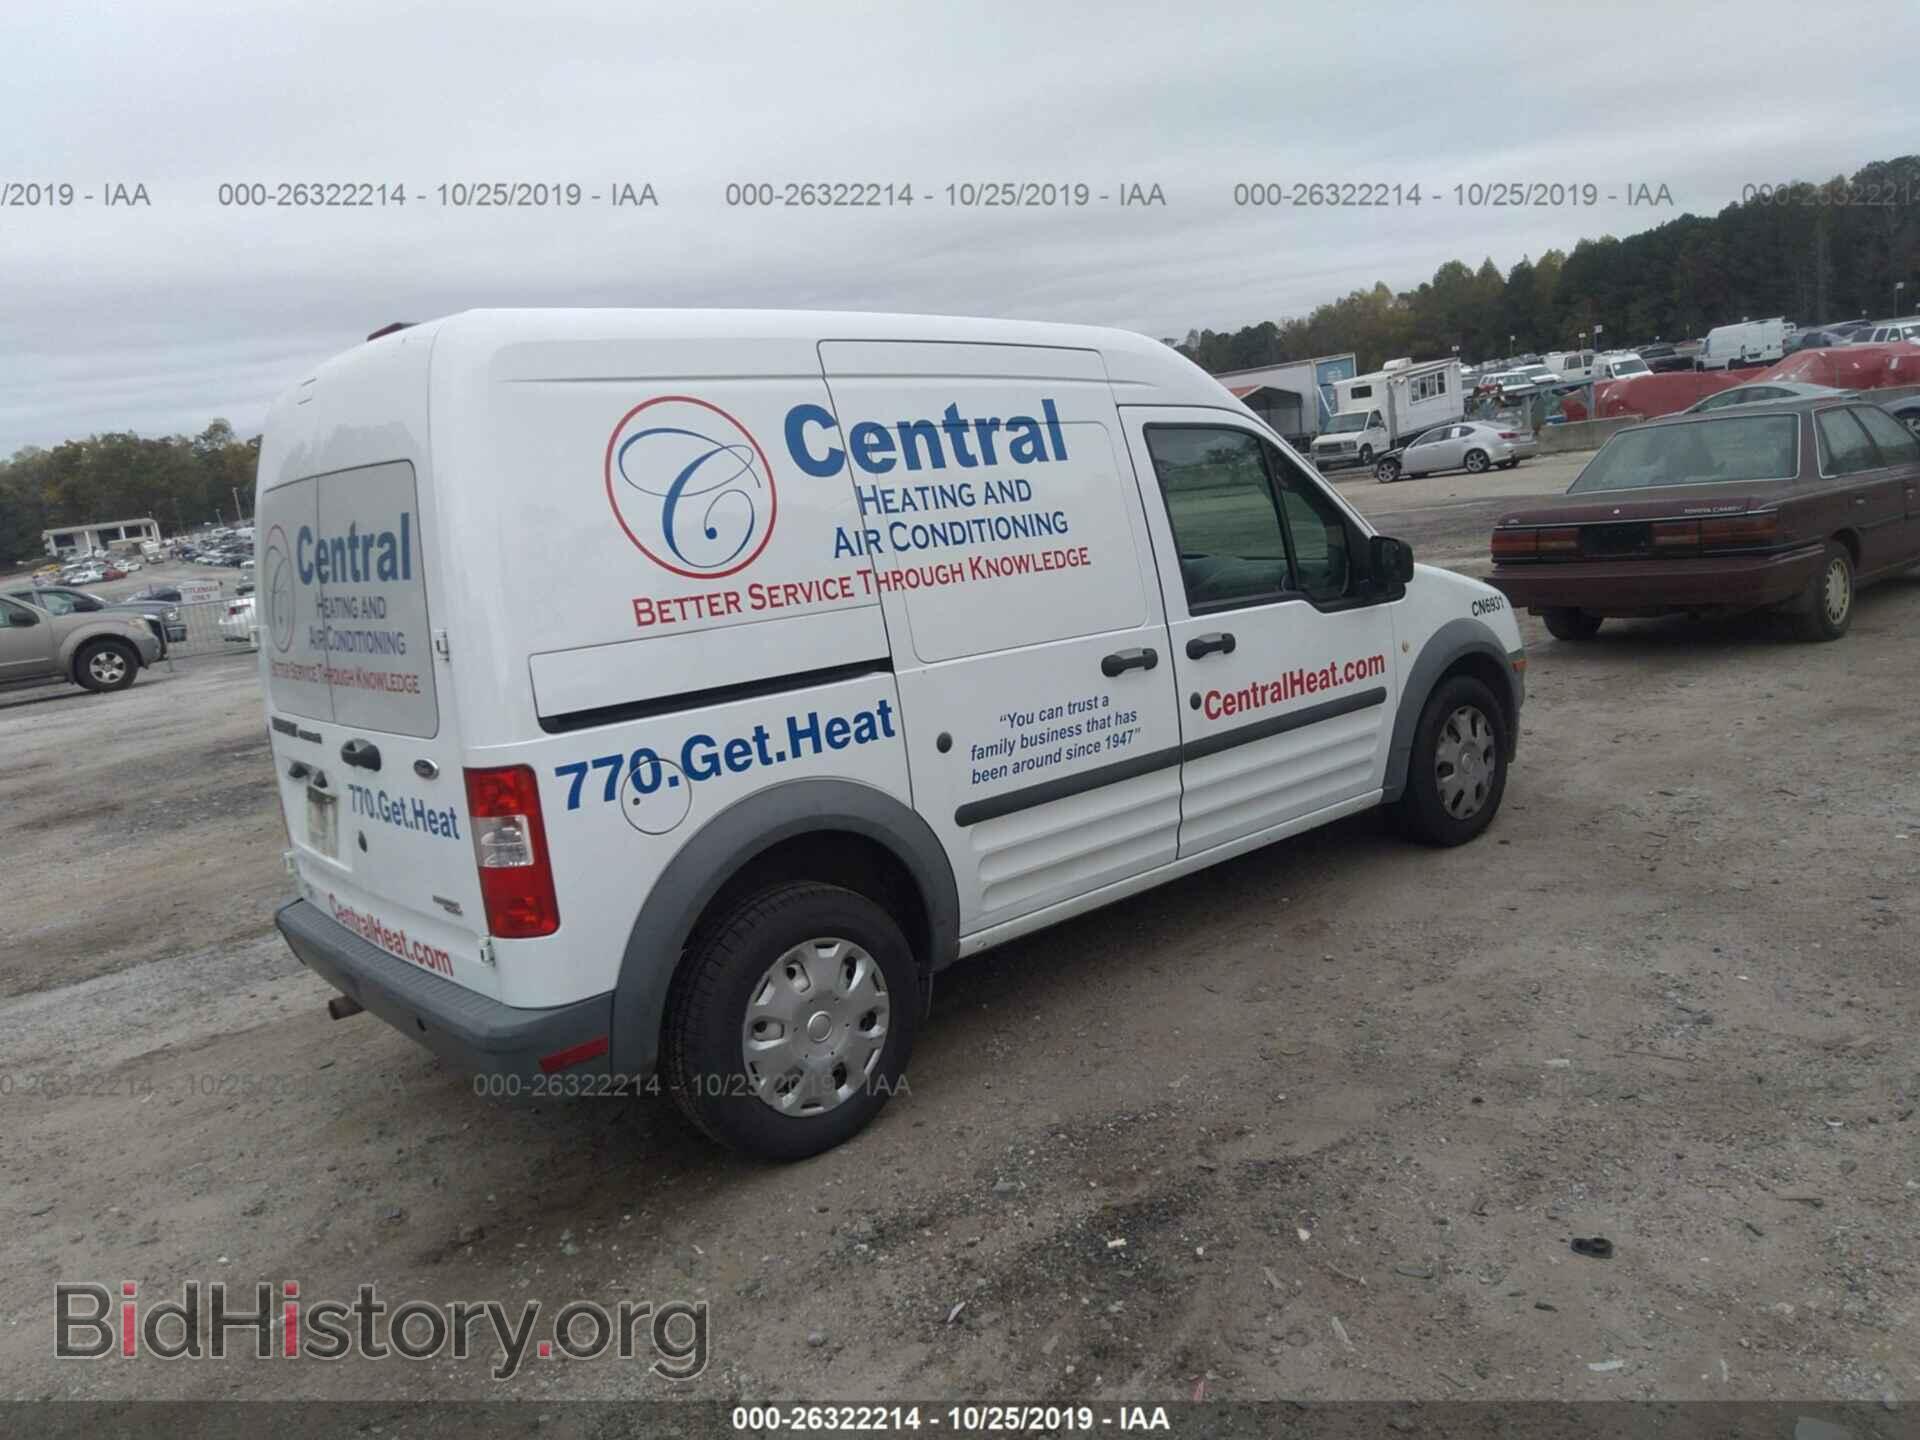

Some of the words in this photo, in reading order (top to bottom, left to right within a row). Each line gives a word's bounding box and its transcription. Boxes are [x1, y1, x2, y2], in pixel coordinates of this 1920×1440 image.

[784, 398, 1069, 478] Central
[856, 482, 975, 516] HEATING
[984, 479, 1032, 505] AND
[297, 512, 411, 585] Central
[833, 526, 883, 559] AIR
[890, 511, 1069, 552] CONDITIONING
[362, 596, 386, 619] AND
[632, 590, 742, 627] BETTER
[747, 575, 855, 610] SERVICE
[857, 562, 963, 595] THROUGH
[968, 547, 1091, 580] KNOWLEDGE
[1039, 706, 1063, 722] can
[1068, 696, 1098, 715] trust
[1101, 695, 1110, 707] a
[1204, 654, 1385, 720] CentralHeat.com
[555, 699, 895, 811] 770.Get.Heat
[971, 738, 1016, 761] family
[1020, 723, 1082, 750] business
[1086, 717, 1111, 733] that
[1115, 710, 1137, 727] has
[972, 764, 1008, 785] been
[1012, 748, 1062, 775] around
[1065, 740, 1101, 760] since
[348, 784, 460, 840] 770.Get.Heat
[329, 894, 453, 976] CentralHeat.com
